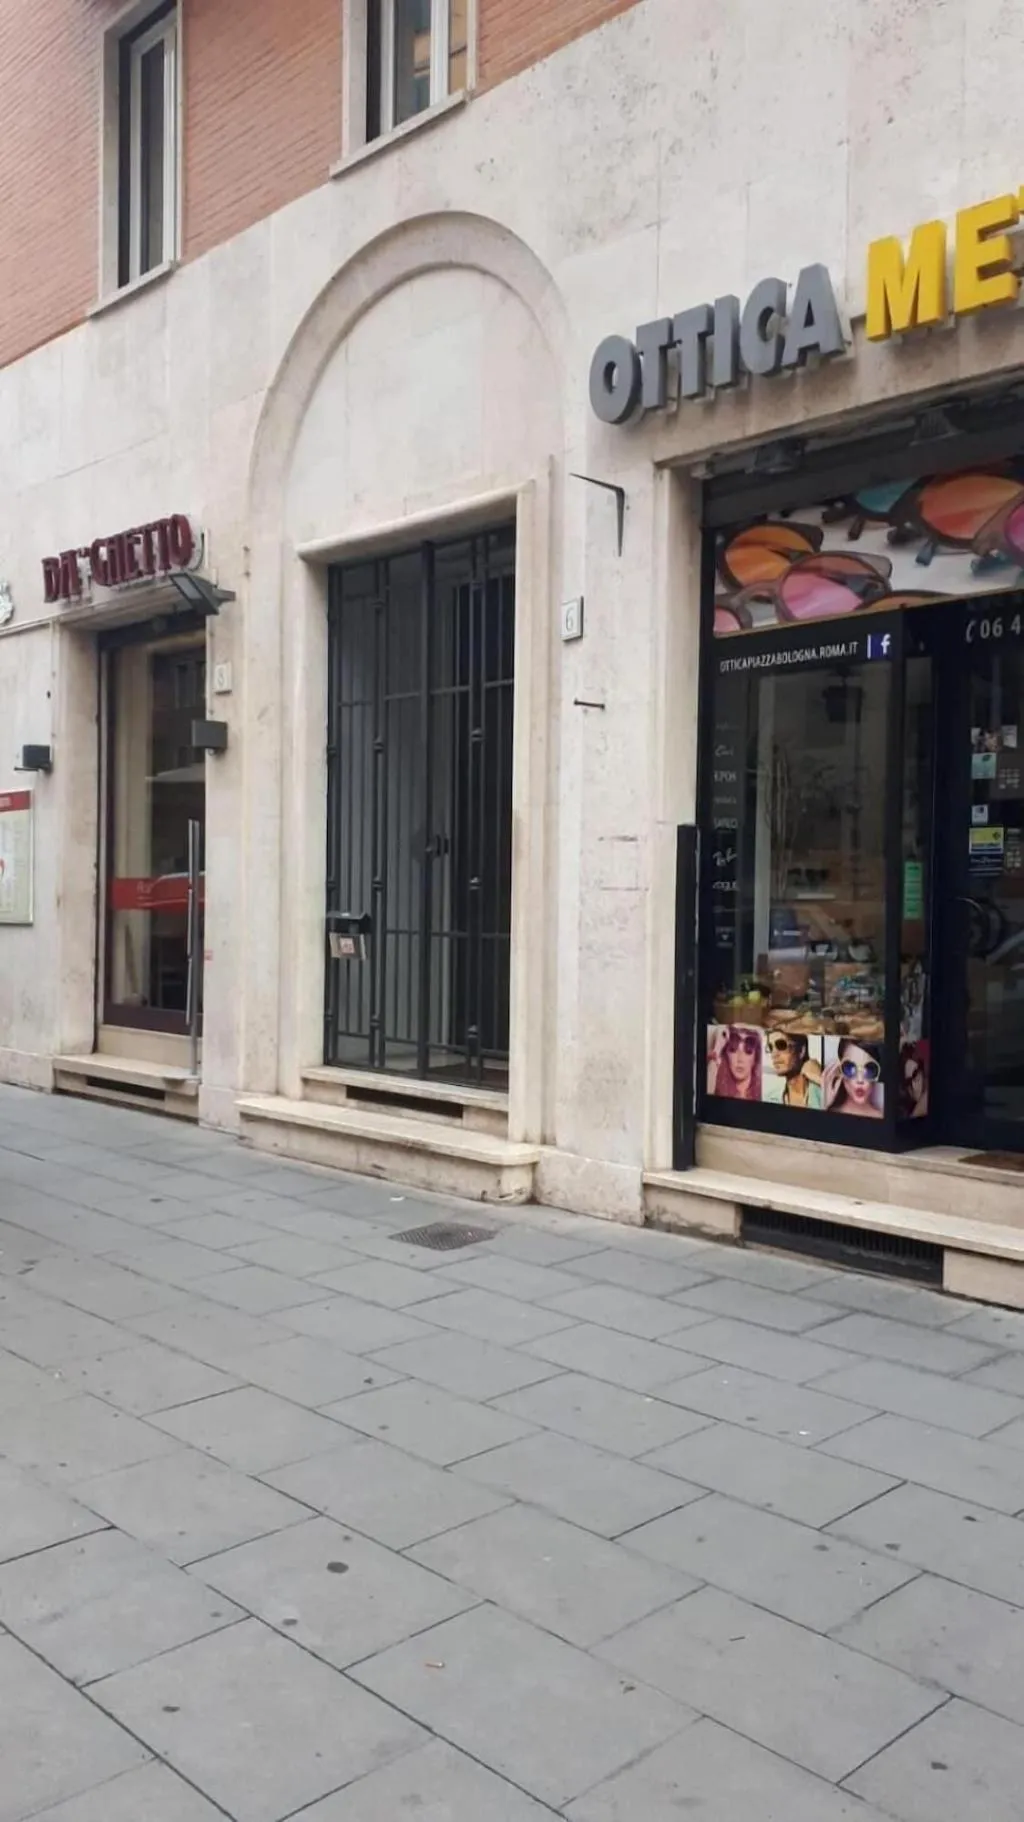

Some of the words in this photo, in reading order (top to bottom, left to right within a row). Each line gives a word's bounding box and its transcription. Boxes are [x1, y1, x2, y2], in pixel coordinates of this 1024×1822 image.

[589, 263, 845, 424] OTTICA
[865, 183, 1024, 342] ME
[90, 514, 195, 586] GHETTO
[565, 606, 574, 632] 6
[980, 617, 1003, 639] 06
[720, 641, 859, 673] OTTICAPIAZZABOLOGNA.ROMA.IT
